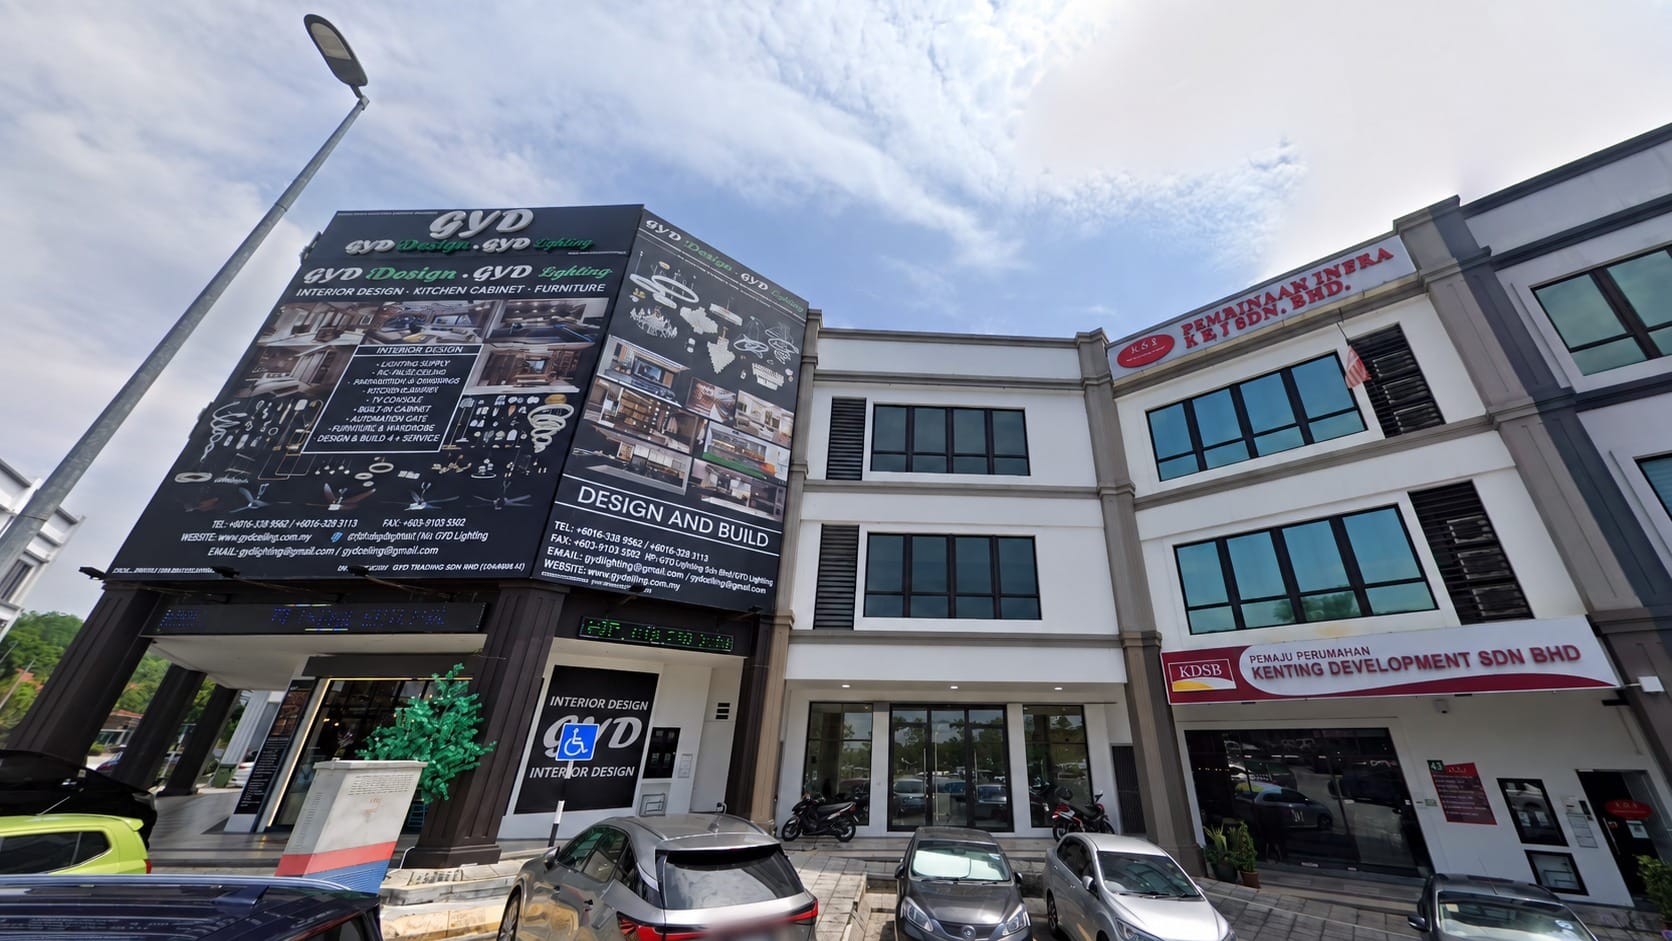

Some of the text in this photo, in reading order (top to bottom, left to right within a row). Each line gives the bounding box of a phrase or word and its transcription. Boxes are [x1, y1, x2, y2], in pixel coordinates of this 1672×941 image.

[430, 209, 534, 240] GYD
[645, 220, 682, 241] GYD
[345, 240, 395, 255] GYD
[482, 237, 594, 253] GYD Lighting
[303, 267, 363, 284] GYD
[473, 265, 613, 281] GYD Lighting
[296, 283, 606, 296] INTERIOR DESIGN KITCHEN CABINET FURNITURE
[740, 273, 769, 290] GYD
[1290, 280, 1352, 310] BHD.
[577, 485, 770, 548] DESIGN AND BUILD
[454, 531, 489, 542] Lighting
[550, 533, 572, 546] FAX:
[554, 521, 574, 533] TEL:
[622, 536, 643, 548] 9562
[547, 546, 583, 561] EMAIL:
[544, 558, 587, 574] WEBSITE:
[1250, 646, 1371, 664] PEMAJU PERUMAHAN
[1251, 644, 1582, 681] KENTING DEVELOPMENT SDN BHD
[1179, 663, 1222, 678] KDSB
[550, 696, 649, 711] INTERIOR DESIGN
[529, 766, 635, 778] INTEROR DESIGN
